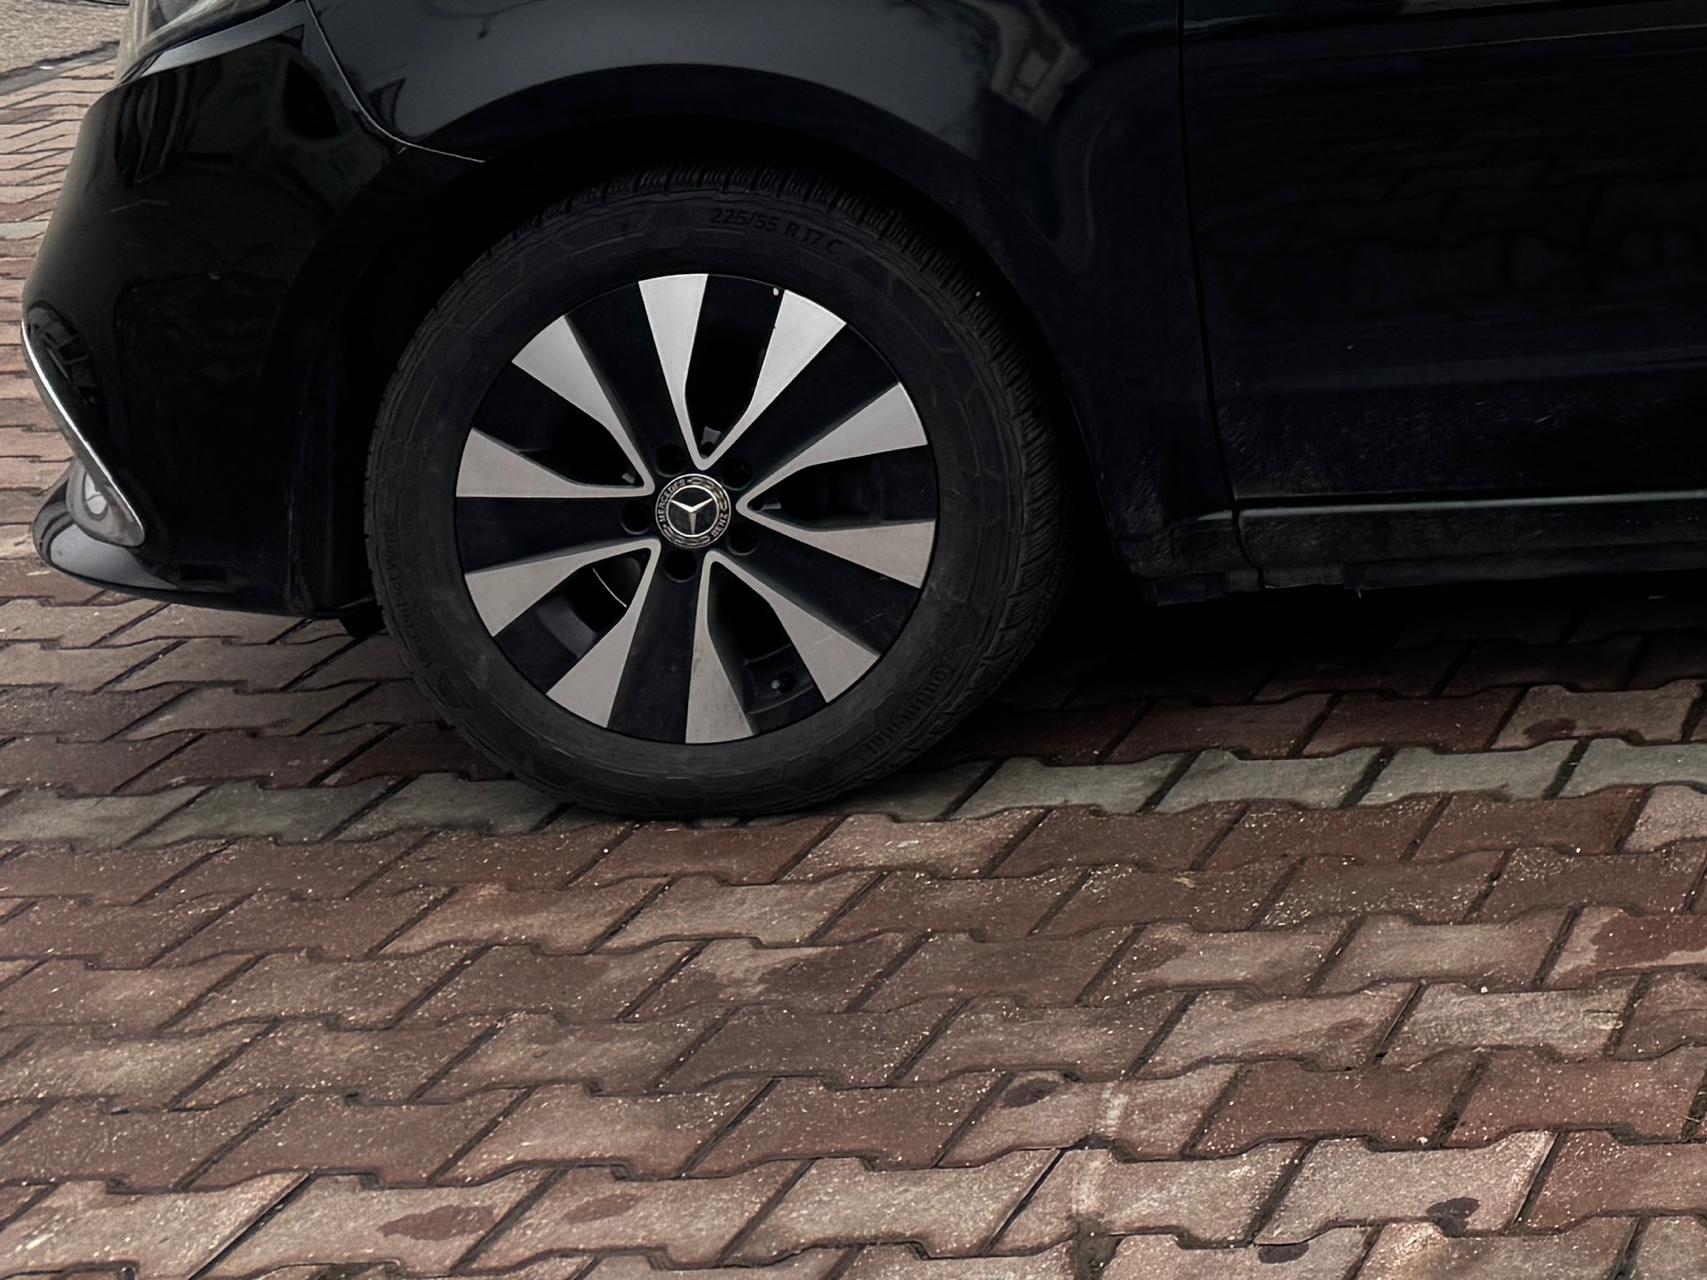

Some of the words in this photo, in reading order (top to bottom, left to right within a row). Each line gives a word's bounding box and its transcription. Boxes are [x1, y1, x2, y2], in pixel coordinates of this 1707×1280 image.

[709, 207, 780, 232] 225/55
[785, 221, 800, 238] R
[803, 227, 825, 245] 17
[825, 238, 843, 256] C
